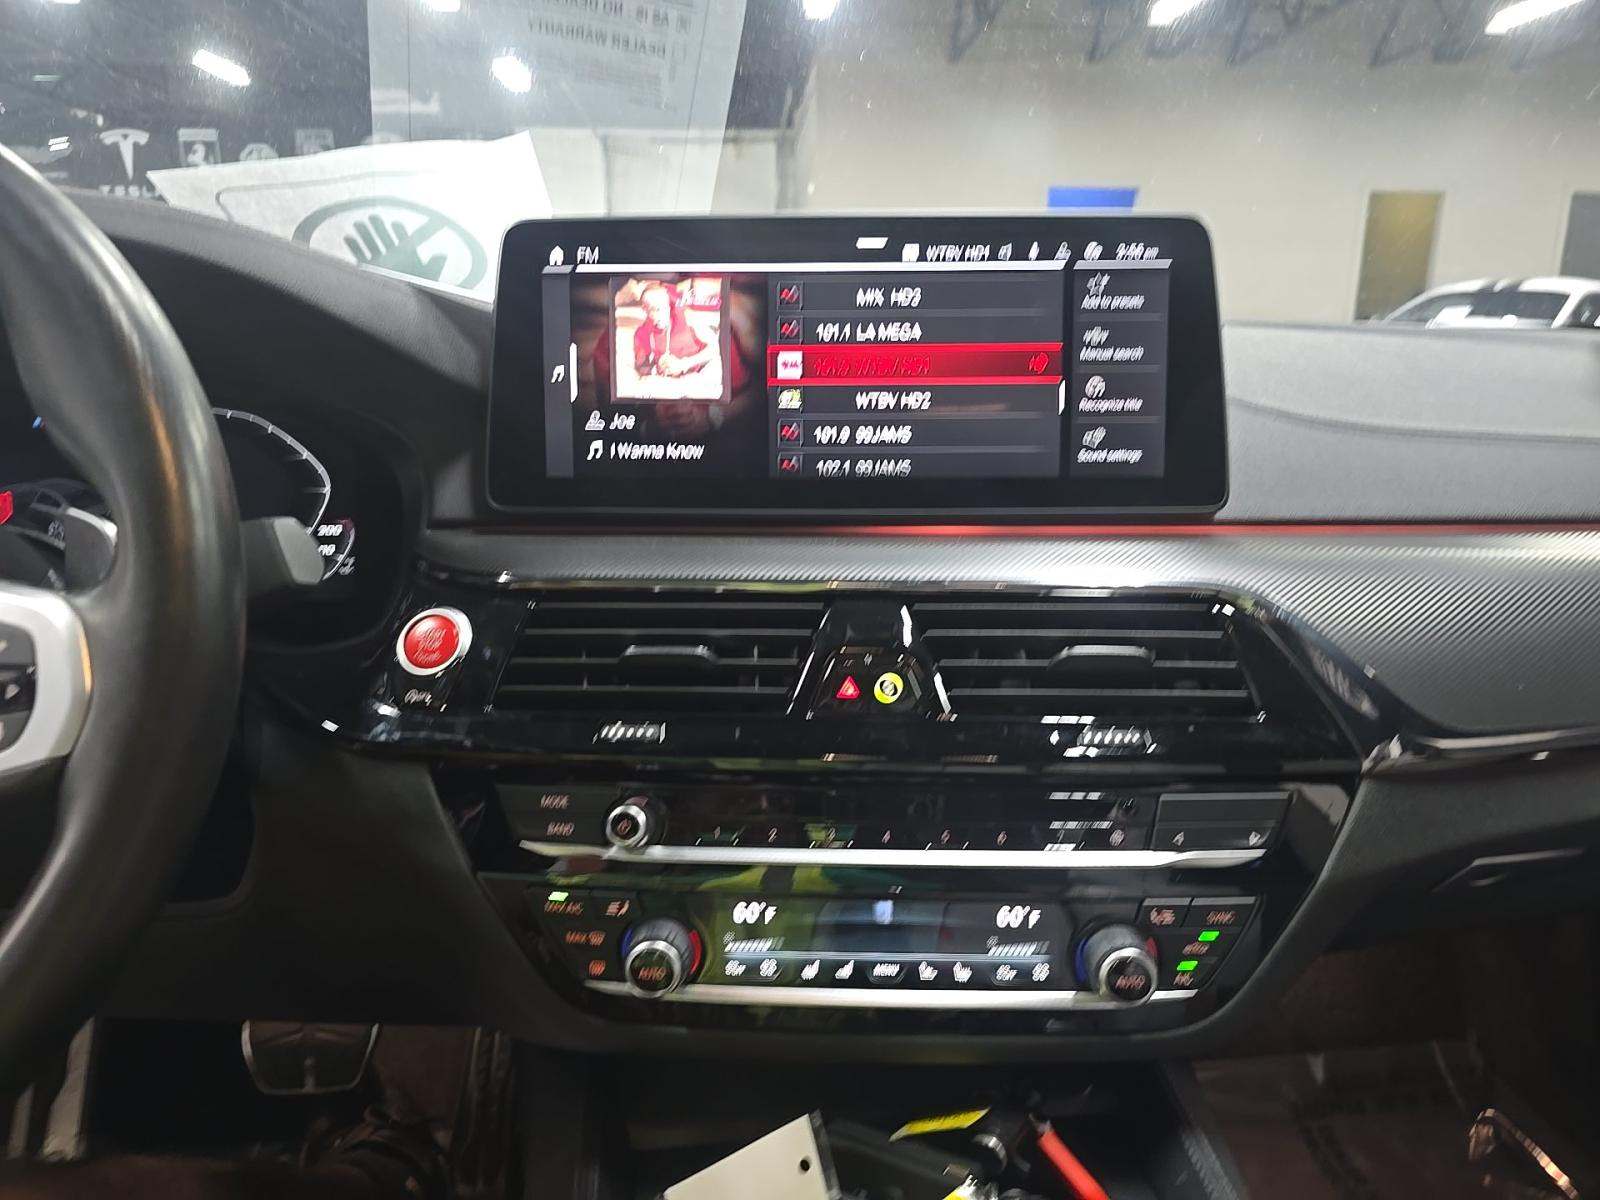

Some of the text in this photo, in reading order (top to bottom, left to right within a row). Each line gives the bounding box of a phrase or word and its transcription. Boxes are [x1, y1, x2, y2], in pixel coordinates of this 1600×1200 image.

[577, 246, 599, 264] FM
[856, 287, 885, 308] MIX
[815, 321, 922, 342] 101.1 LA MEGA
[900, 391, 932, 410] HD2
[609, 412, 635, 430] Joe
[610, 442, 705, 460] I Wanna Know
[1076, 448, 1144, 464] Sound settings
[815, 459, 851, 477] 102.1
